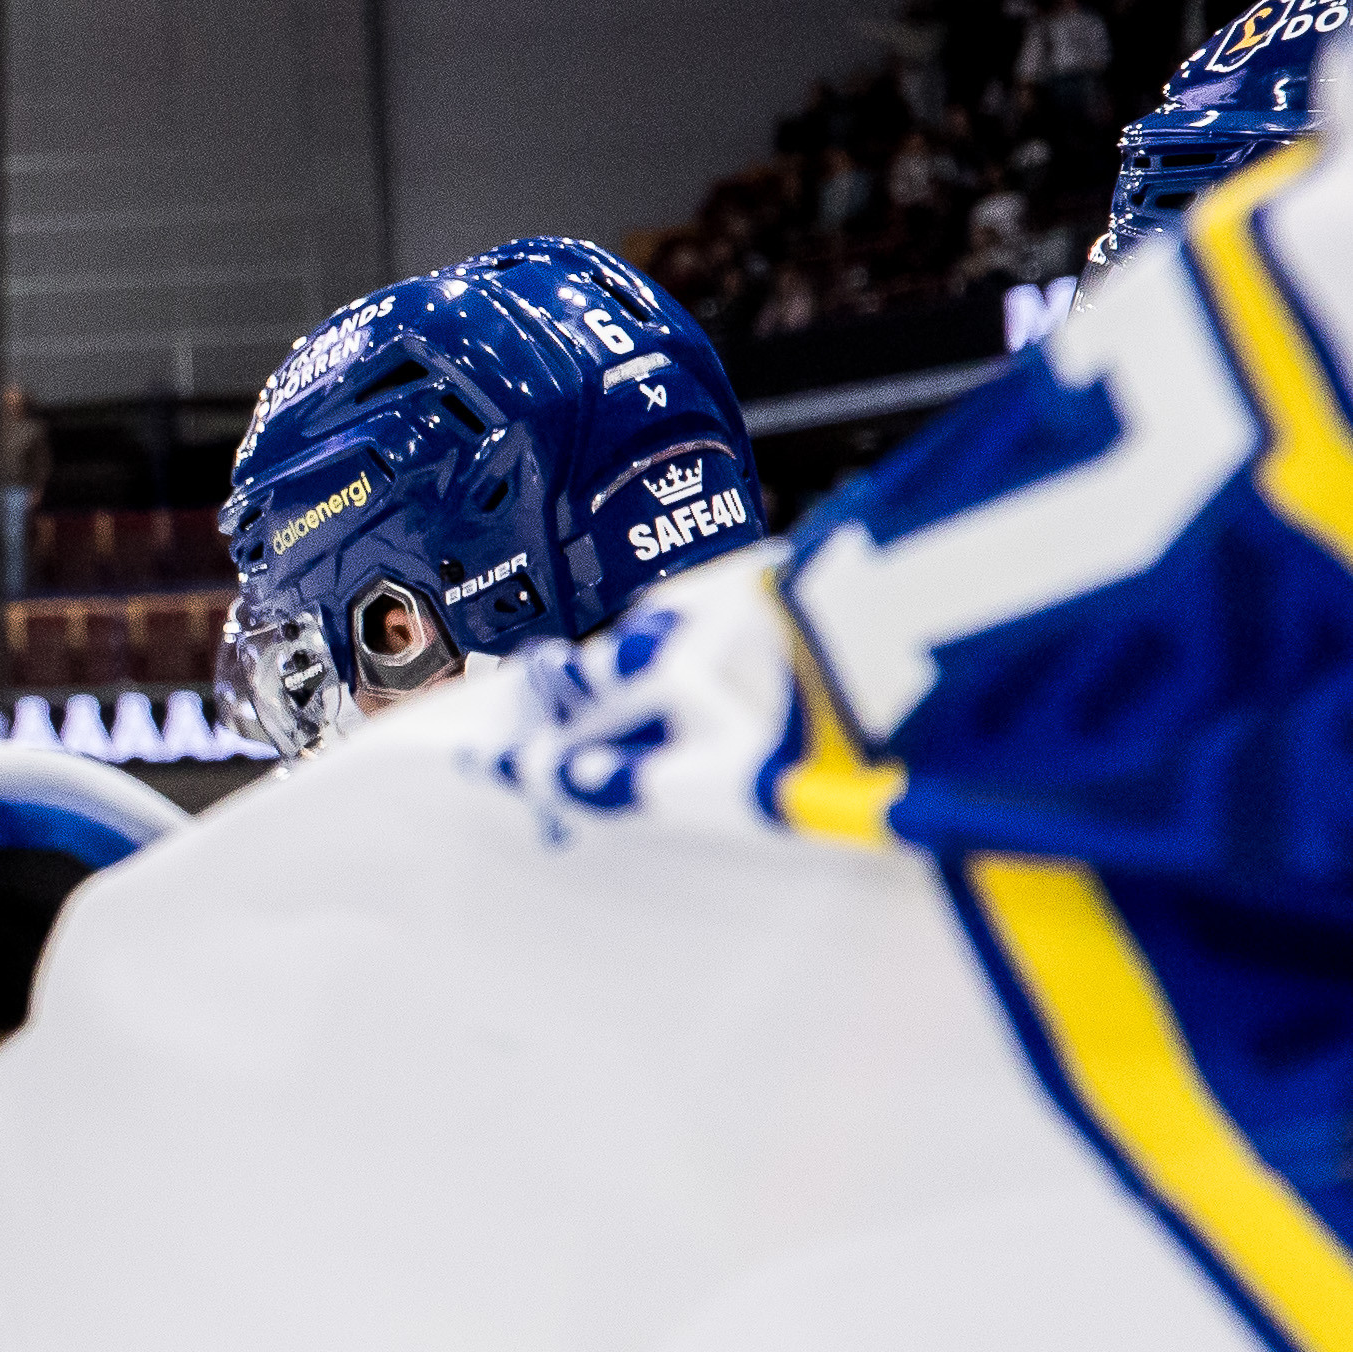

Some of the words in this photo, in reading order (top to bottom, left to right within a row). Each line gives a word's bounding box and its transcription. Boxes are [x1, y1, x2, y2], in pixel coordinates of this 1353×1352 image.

[583, 308, 635, 355] 6
[272, 471, 372, 555] dalaenergi
[628, 488, 746, 561] SAFE4U
